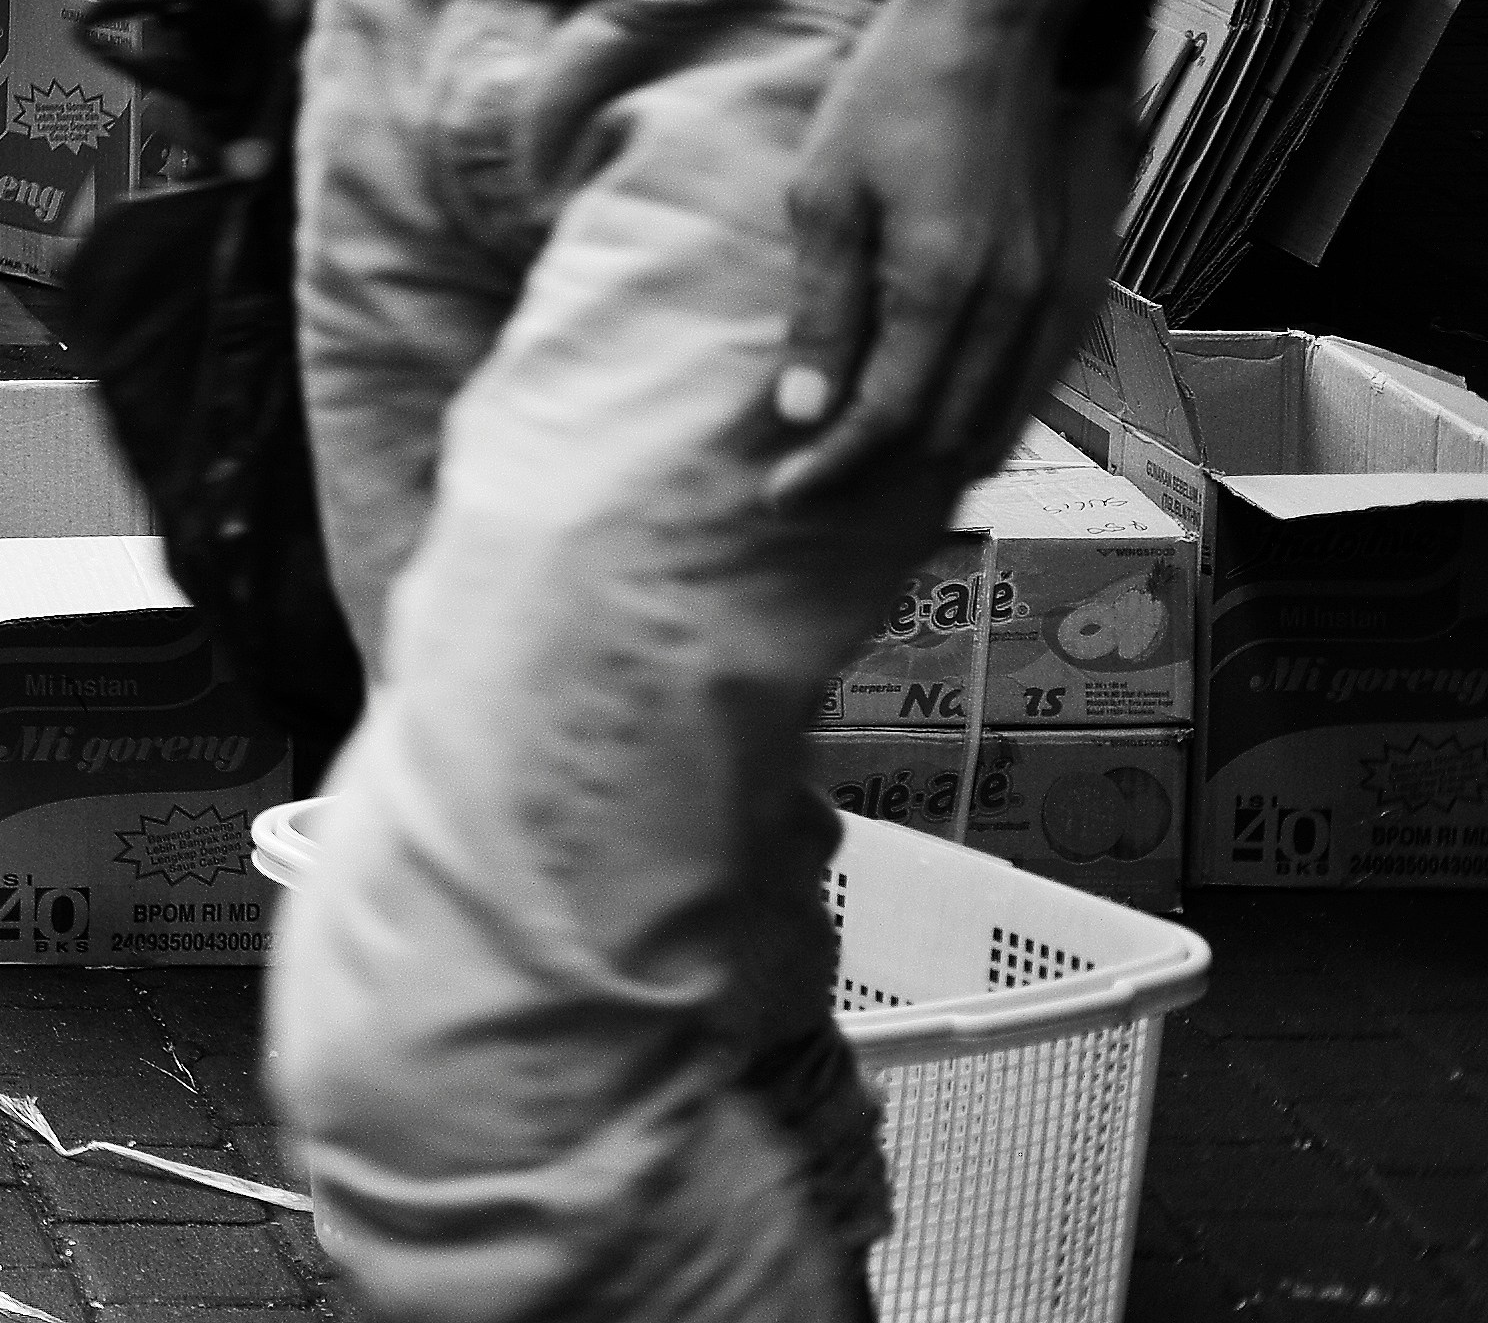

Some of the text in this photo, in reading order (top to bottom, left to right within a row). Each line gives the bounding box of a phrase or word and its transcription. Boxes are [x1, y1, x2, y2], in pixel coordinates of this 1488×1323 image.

[24, 674, 138, 697] Mi Instan
[77, 733, 252, 774] goreng
[192, 822, 235, 836] Goreng
[222, 830, 243, 843] dan
[1372, 826, 1457, 848] BPOM RI
[133, 903, 262, 924] BPOM RI MD
[35, 941, 91, 954] BKS
